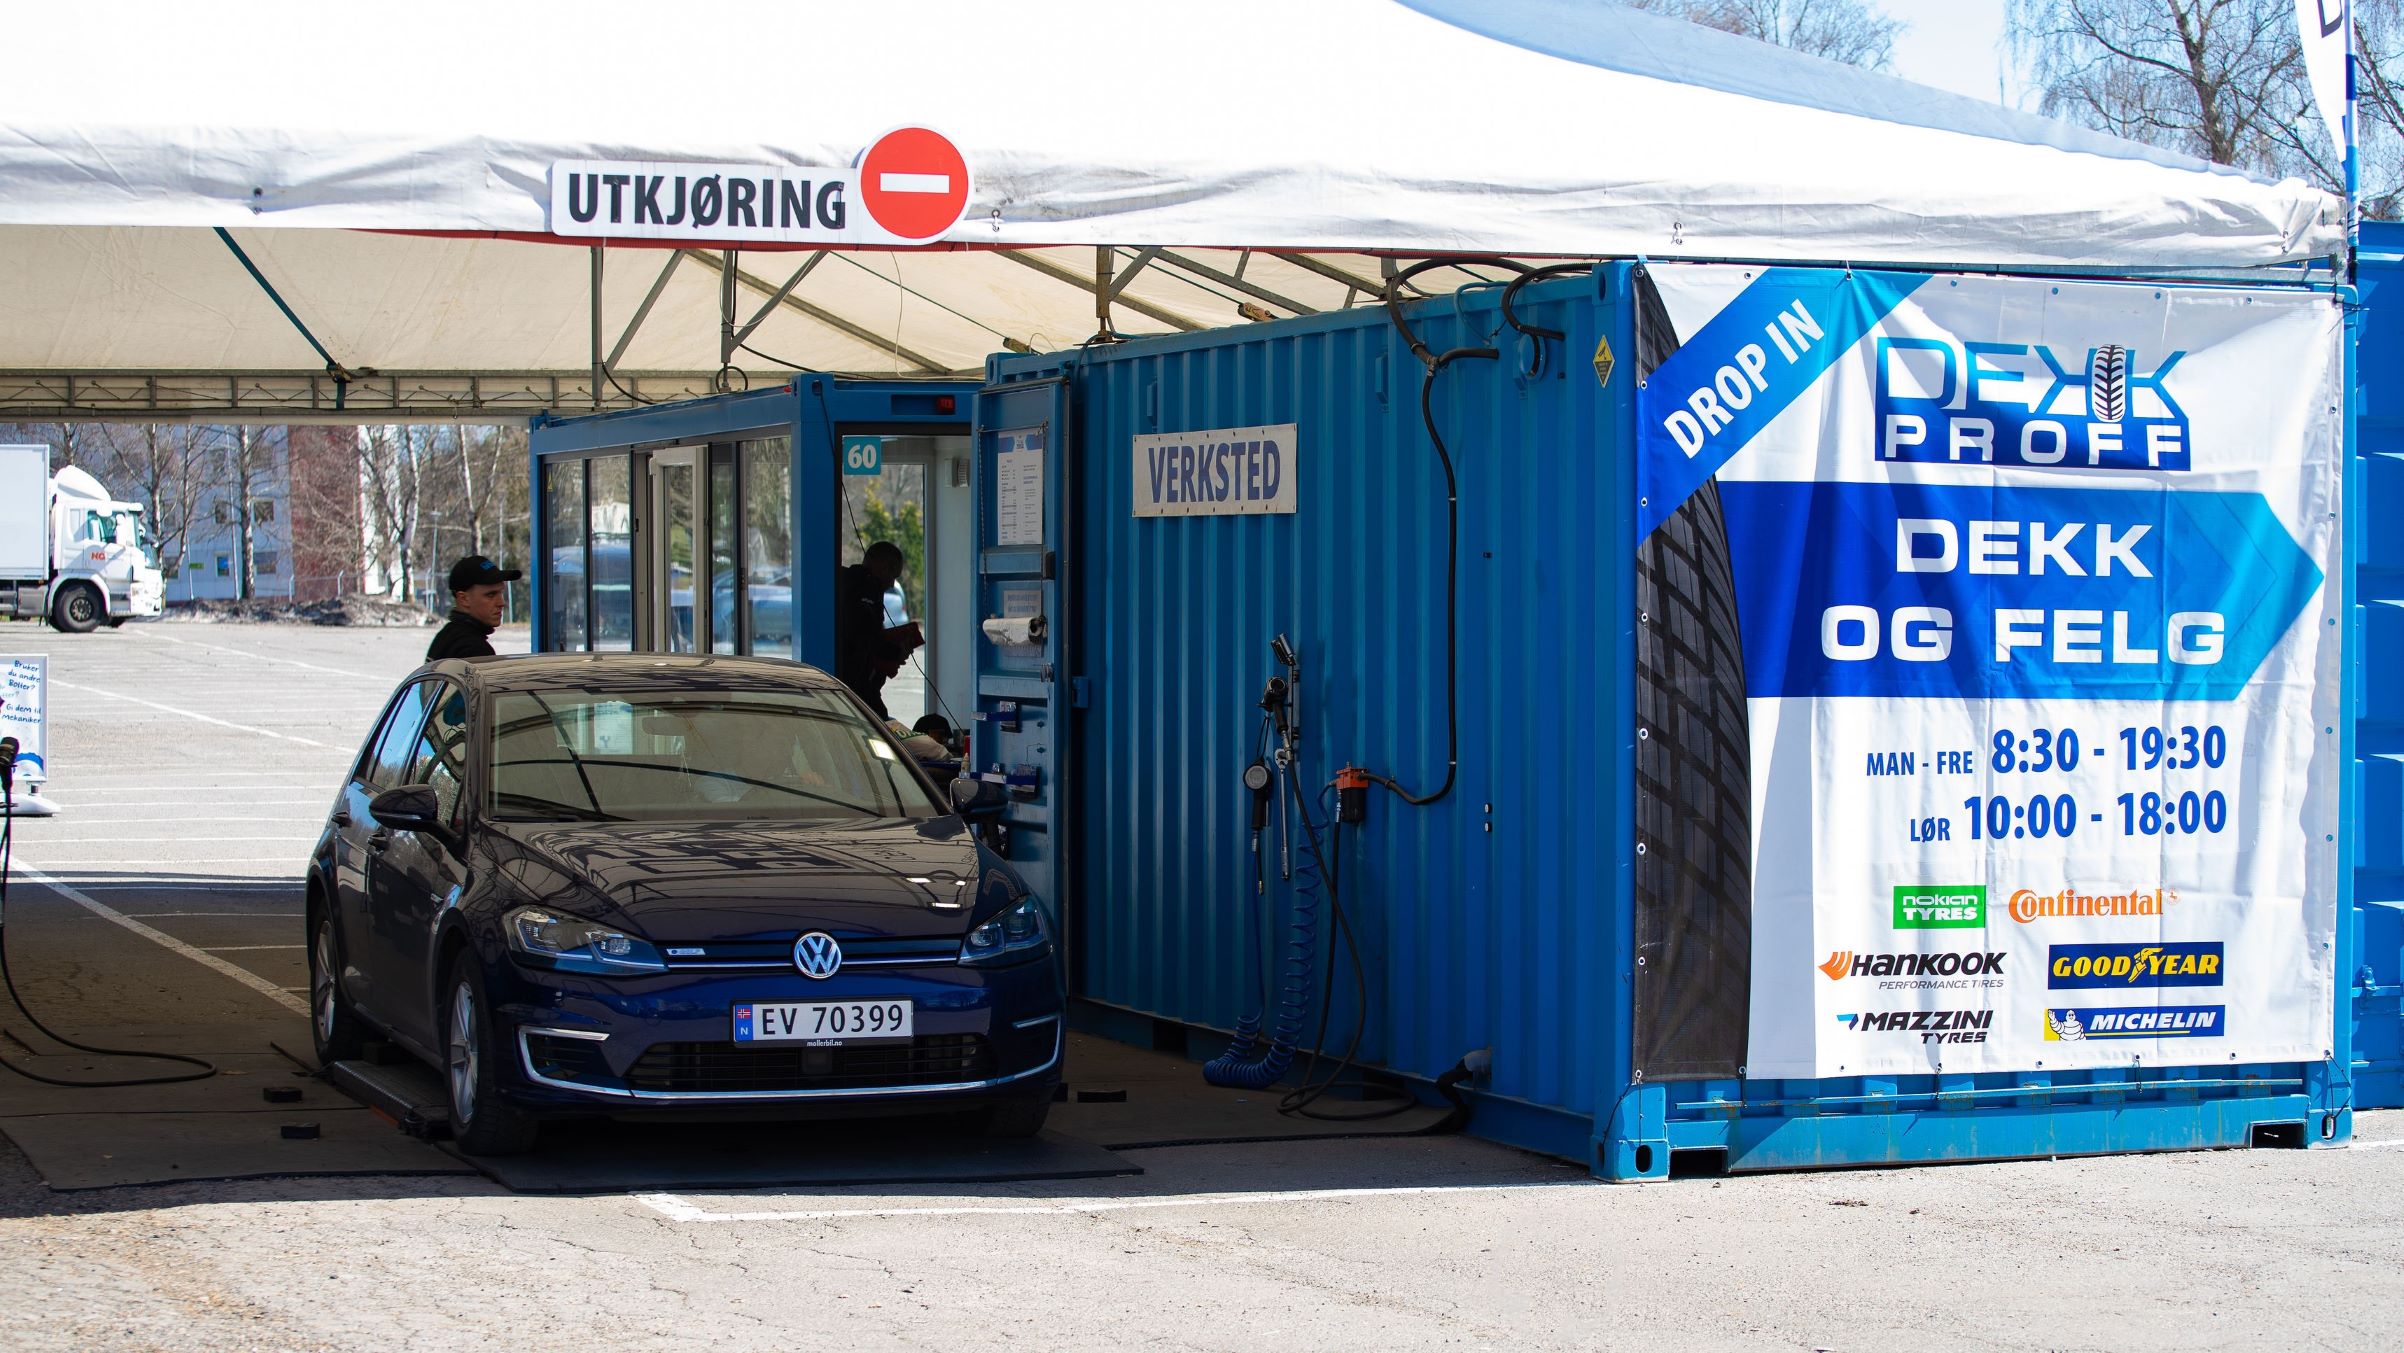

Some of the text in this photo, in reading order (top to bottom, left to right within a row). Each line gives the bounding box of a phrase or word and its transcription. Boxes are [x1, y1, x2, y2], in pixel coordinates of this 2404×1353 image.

[568, 174, 846, 230] UTKJØRING
[1663, 298, 1825, 459] DROP IN
[847, 443, 877, 470] 60
[1884, 413, 2182, 467] PROFF
[1147, 440, 1281, 504] VERKSTED
[1896, 517, 2155, 578] DEKK
[1821, 604, 2226, 666] OG FELG
[1866, 752, 1915, 776] MAN
[1937, 751, 1973, 774] FRE
[1991, 728, 2080, 774] 8:30
[2119, 725, 2227, 770] 19:30
[1910, 817, 1950, 843] LØR
[1964, 794, 2077, 840] 10:00
[2117, 790, 2227, 836] 18:00
[1902, 907, 1978, 921] TYRES
[2008, 888, 2164, 924] Continental
[1878, 979, 2004, 990] PERFORMANCE TIRES
[740, 1004, 903, 1036] N EV 70399
[1861, 1010, 1994, 1031] MAZZINI
[1920, 1031, 1988, 1044] TYRES
[2089, 1011, 2217, 1031] MICHELIN
